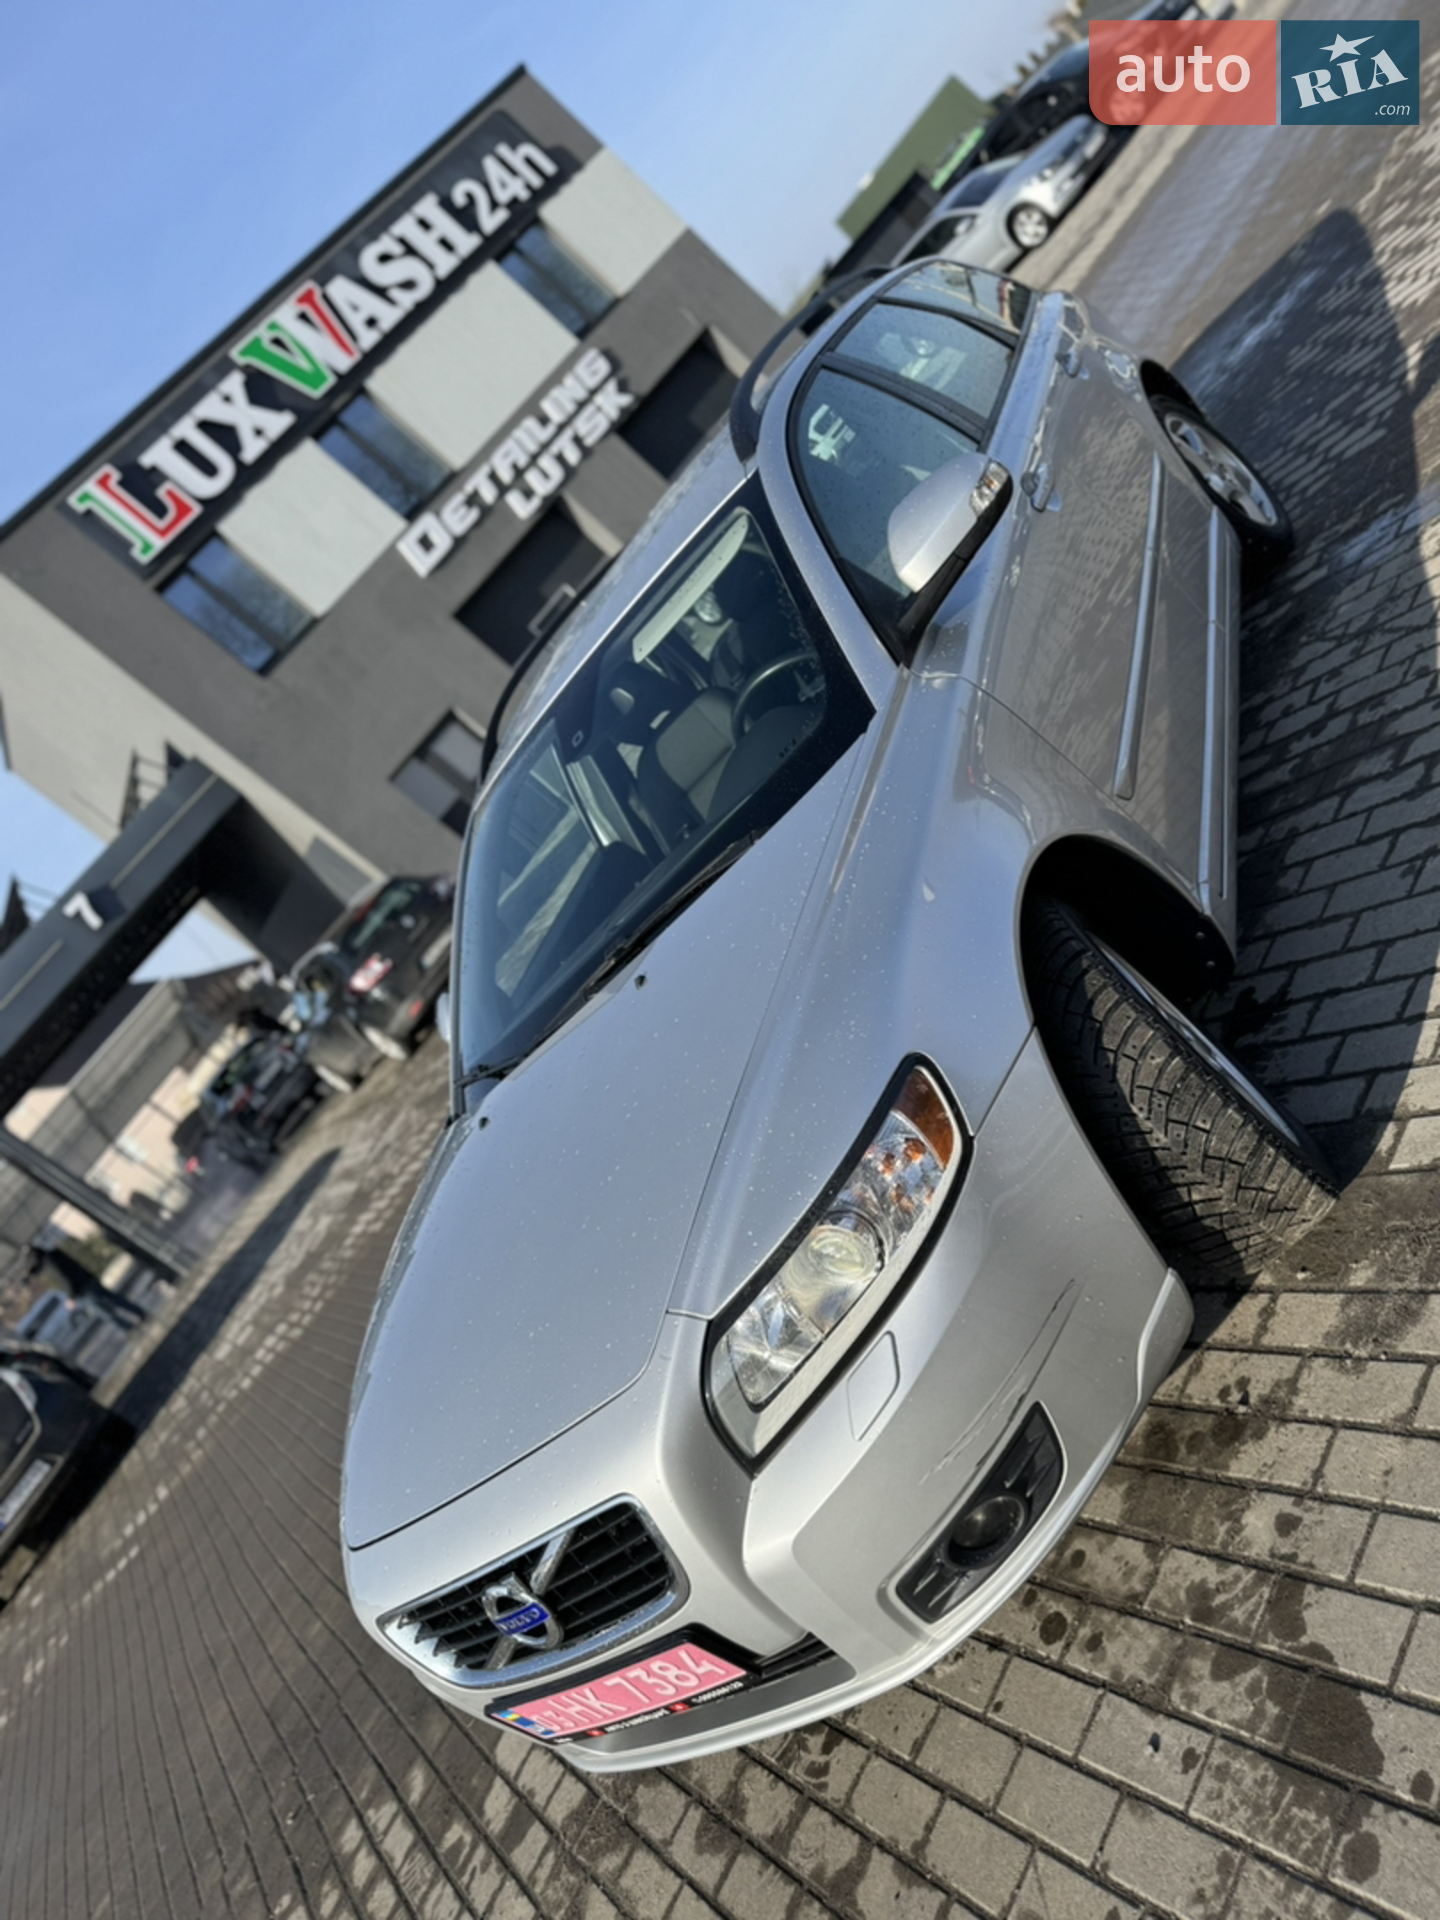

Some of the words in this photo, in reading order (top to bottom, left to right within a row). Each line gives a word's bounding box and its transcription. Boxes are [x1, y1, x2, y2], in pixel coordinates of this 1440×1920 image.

[66, 368, 297, 566] LUX
[229, 191, 484, 399] WASH
[450, 142, 558, 236] 24h
[396, 347, 612, 578] DETAILING
[504, 376, 634, 520] LUTSK
[62, 891, 103, 931] 7
[498, 1608, 541, 1631] VOLVO
[604, 1650, 727, 1704] 7384
